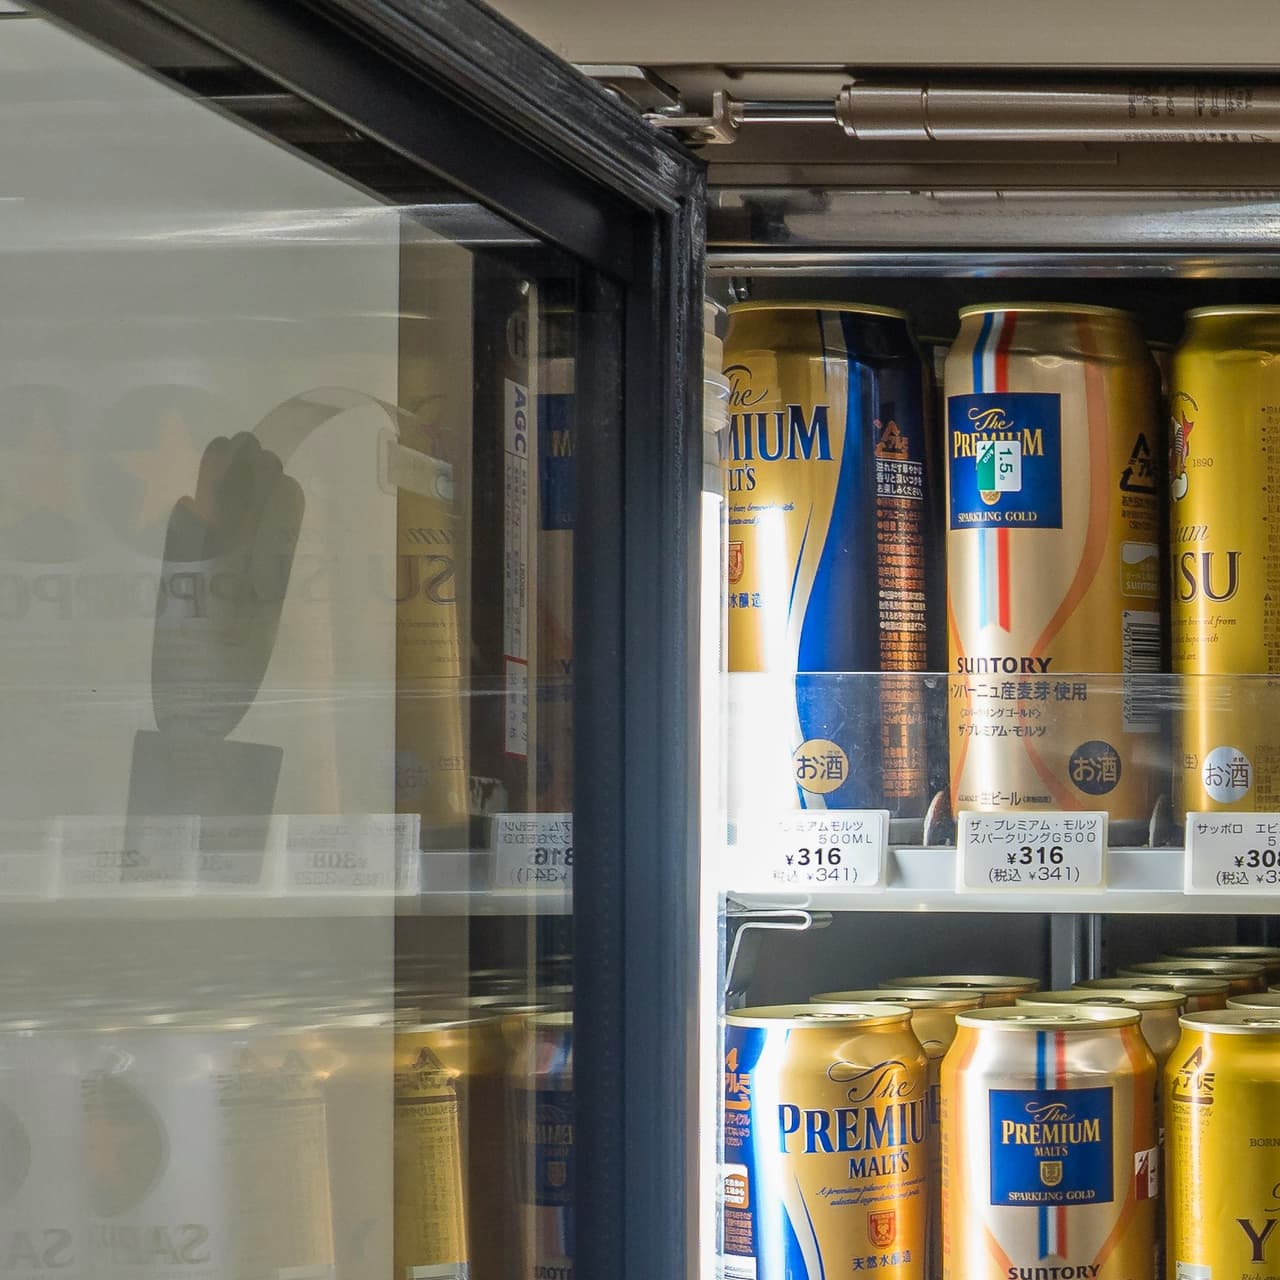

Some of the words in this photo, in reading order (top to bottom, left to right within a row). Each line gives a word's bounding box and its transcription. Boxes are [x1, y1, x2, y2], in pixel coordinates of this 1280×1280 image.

[958, 656, 1051, 673] SUNTORY
[1073, 755, 1118, 781] お酒
[786, 848, 841, 865] ¥316
[1008, 846, 1063, 864] ¥316
[778, 1103, 929, 1154] PREMIU
[1001, 1120, 1101, 1144] PREMIUM
[1008, 1190, 1064, 1201] SPARKLING
[1065, 1189, 1095, 1199] GOLD
[1008, 1265, 1099, 1280] SUNTORY
